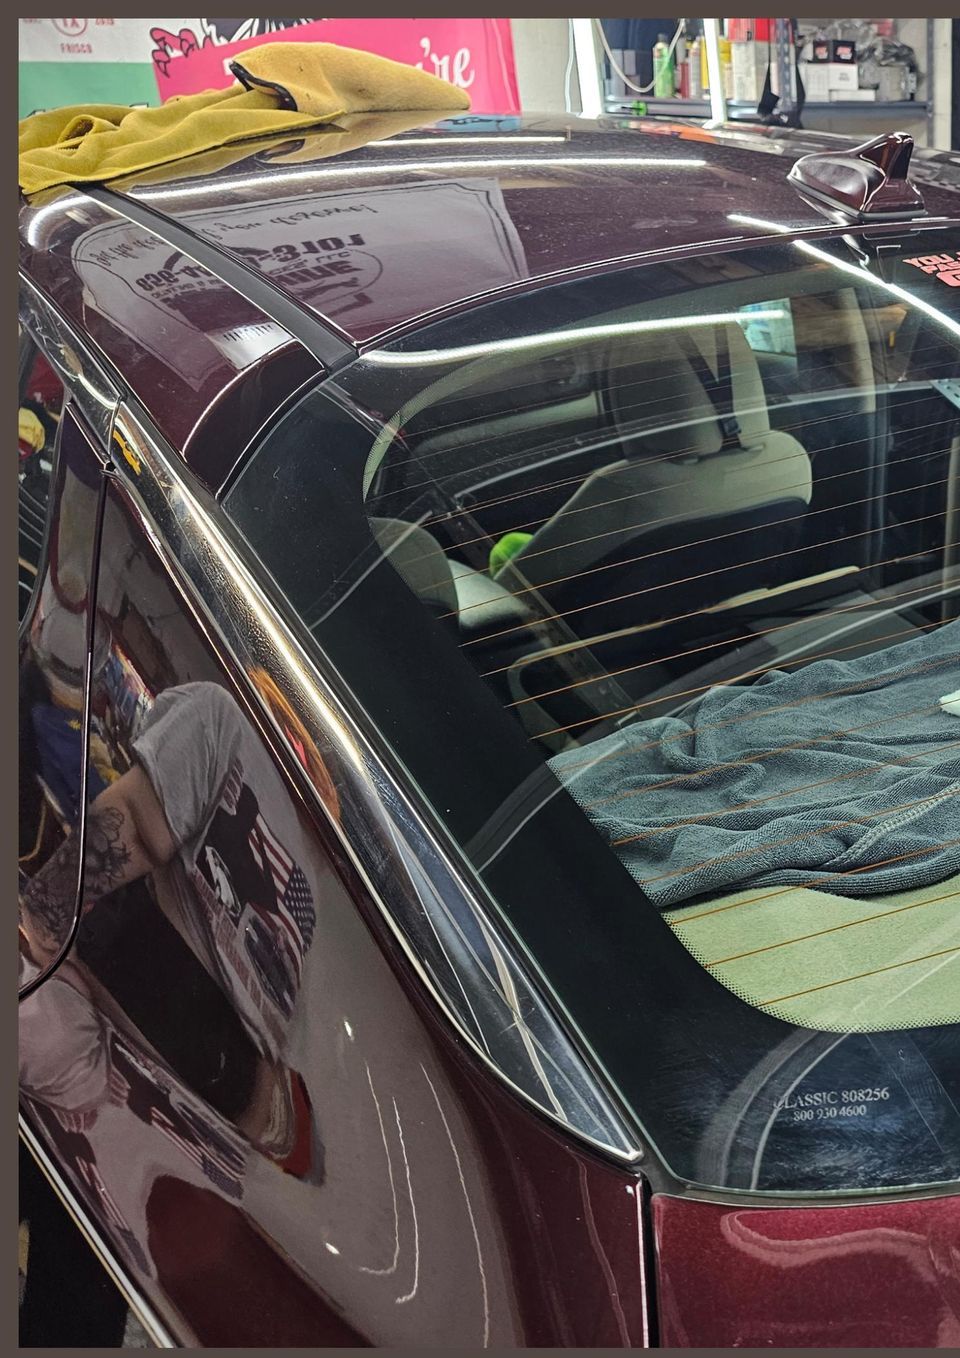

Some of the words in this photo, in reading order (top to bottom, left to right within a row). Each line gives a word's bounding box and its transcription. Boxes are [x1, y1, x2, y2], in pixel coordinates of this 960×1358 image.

[902, 253, 955, 269] YOU
[841, 1086, 890, 1103] 808256
[793, 1109, 815, 1122] 800
[816, 1107, 838, 1120] 930
[838, 1104, 868, 1117] 4600
